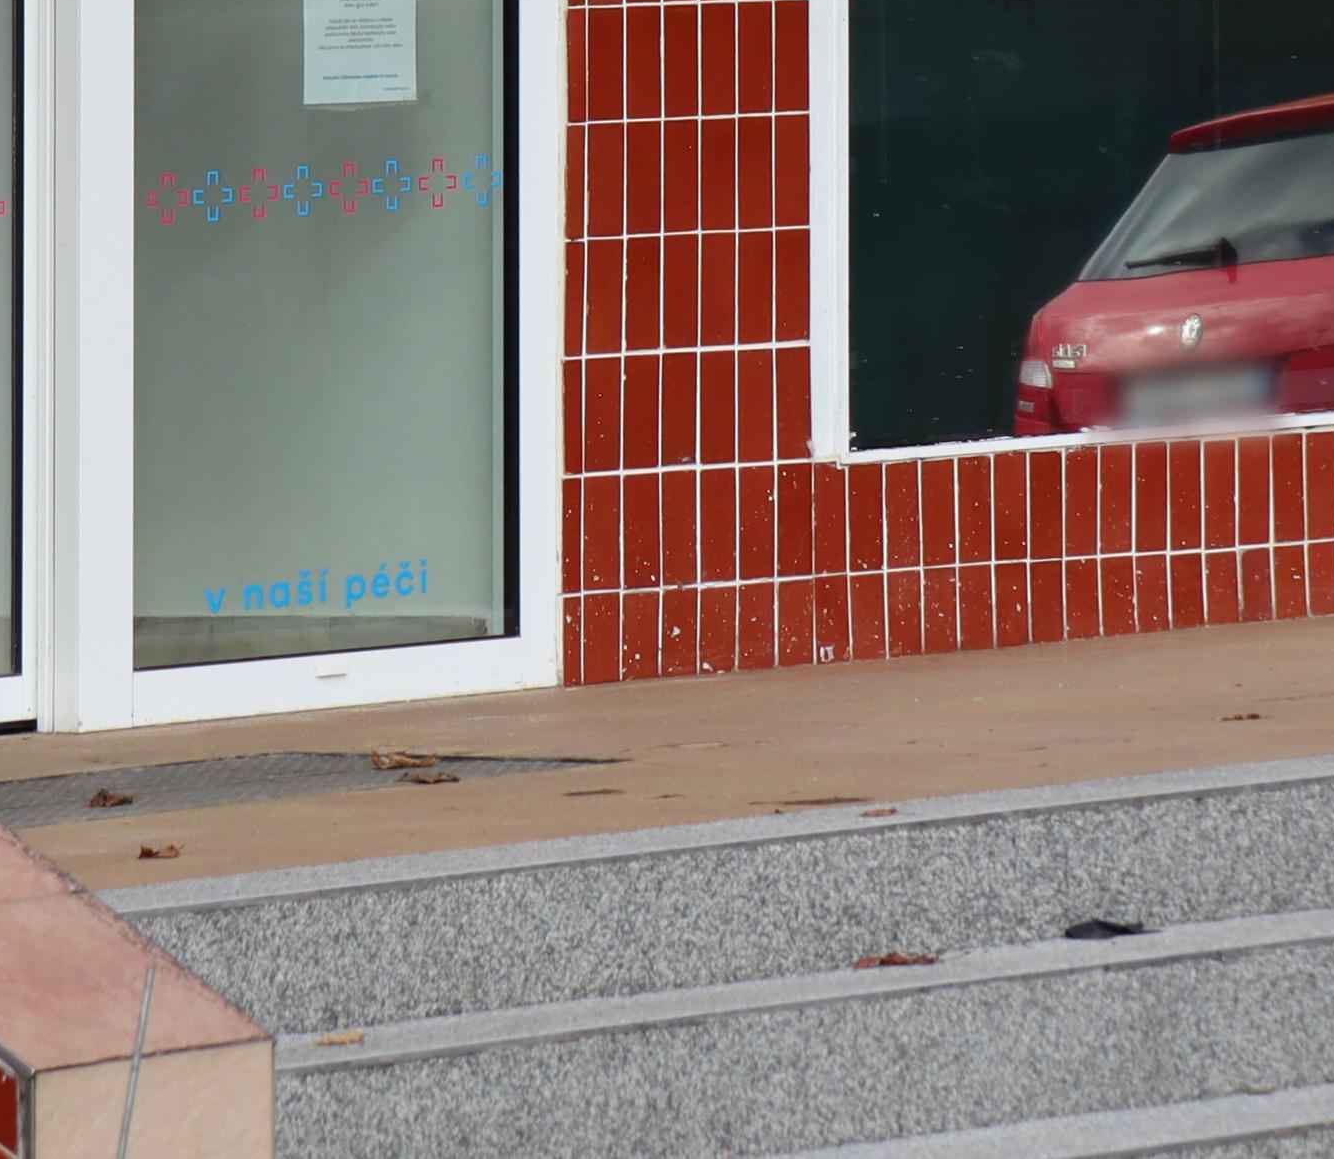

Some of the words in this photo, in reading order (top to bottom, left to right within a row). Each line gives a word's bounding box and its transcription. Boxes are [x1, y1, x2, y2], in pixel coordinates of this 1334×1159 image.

[204, 587, 226, 614] v
[243, 568, 329, 611] naší
[345, 559, 428, 609] péči
